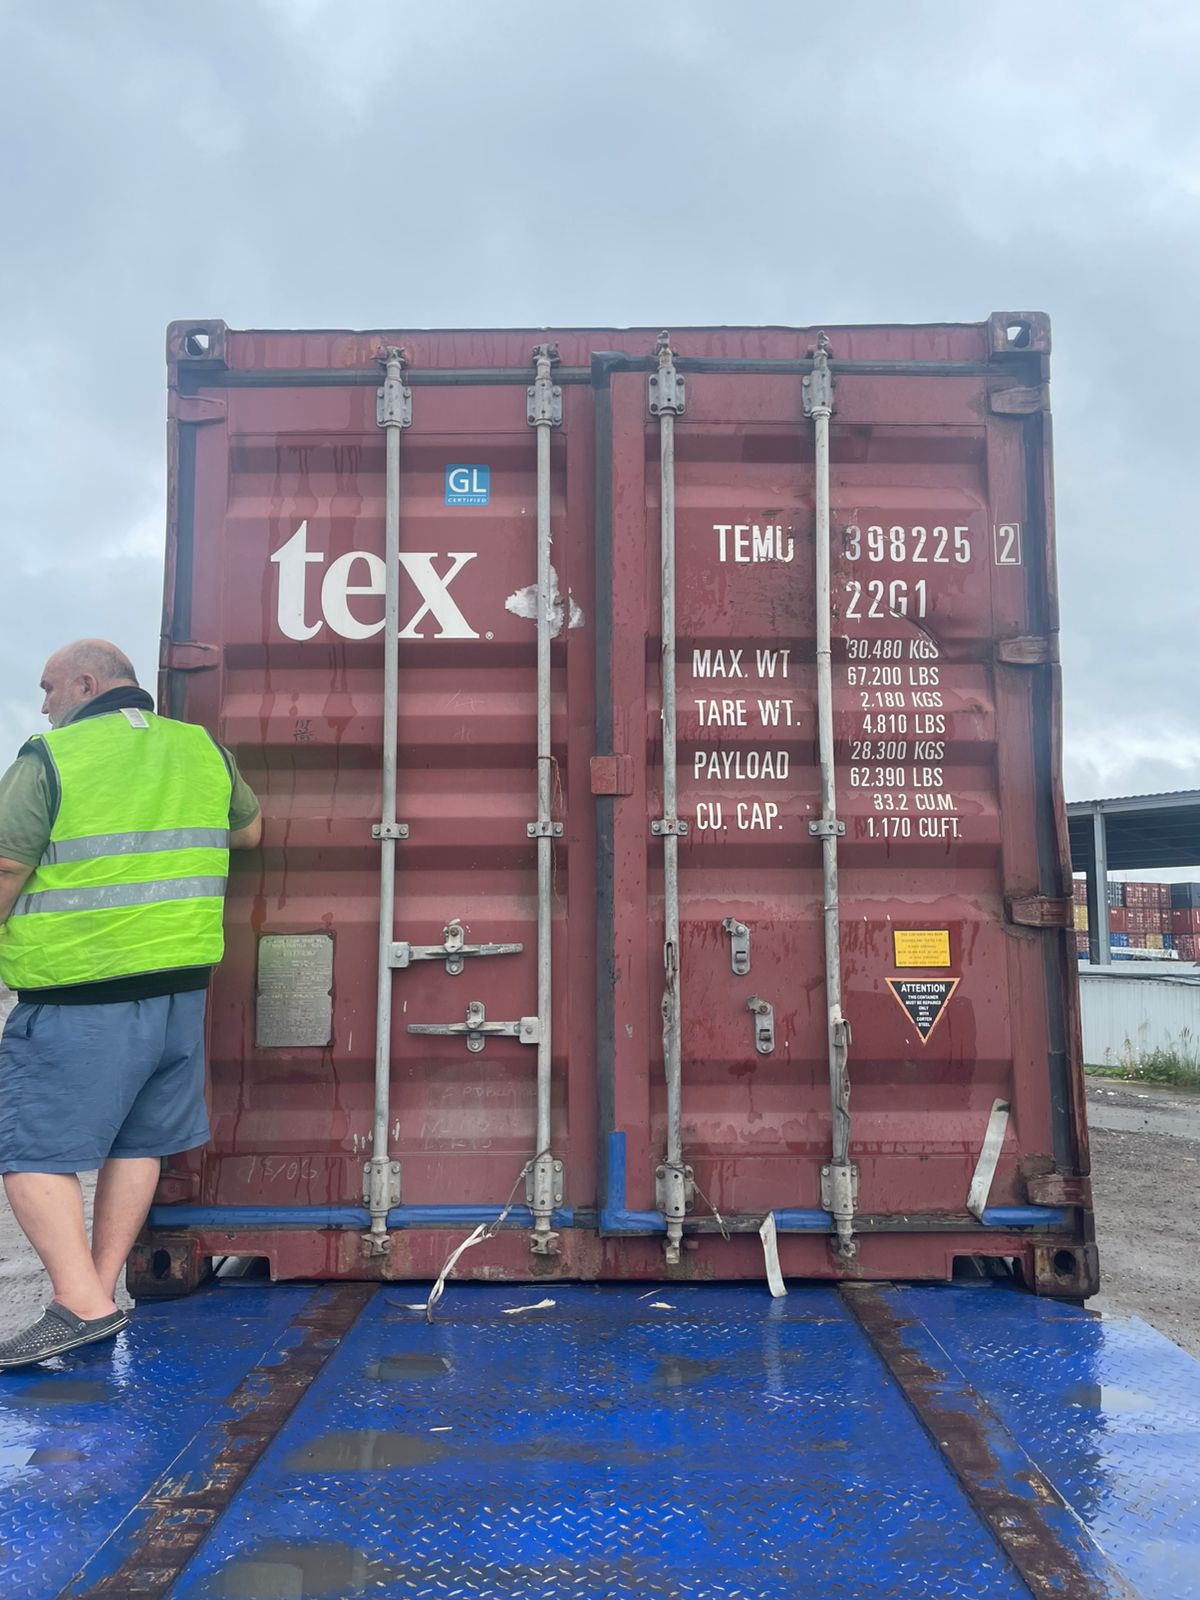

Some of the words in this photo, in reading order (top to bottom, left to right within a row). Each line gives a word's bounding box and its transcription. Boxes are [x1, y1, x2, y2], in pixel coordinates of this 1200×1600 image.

[449, 468, 487, 493] GL
[713, 525, 794, 562] TEMU
[845, 526, 971, 563] 398225
[999, 526, 1016, 563] 2
[846, 579, 927, 619] 22G1
[909, 639, 939, 659] KGS
[693, 649, 748, 678] MAX.
[756, 649, 790, 678] WT
[909, 666, 940, 686] LBS
[911, 692, 943, 708] KGS
[694, 699, 748, 727] TARE
[757, 699, 801, 727] WT.
[915, 714, 946, 734] LBS
[914, 741, 945, 760] KGS
[694, 751, 789, 780] PAYLOAD
[913, 767, 944, 787] LBS
[873, 793, 909, 811] 33.2
[915, 793, 958, 811] CU.M.
[696, 802, 728, 830] CU.
[736, 802, 783, 830] CAP.
[919, 817, 963, 838] CU.FT.
[901, 983, 946, 993] ATTENTION
